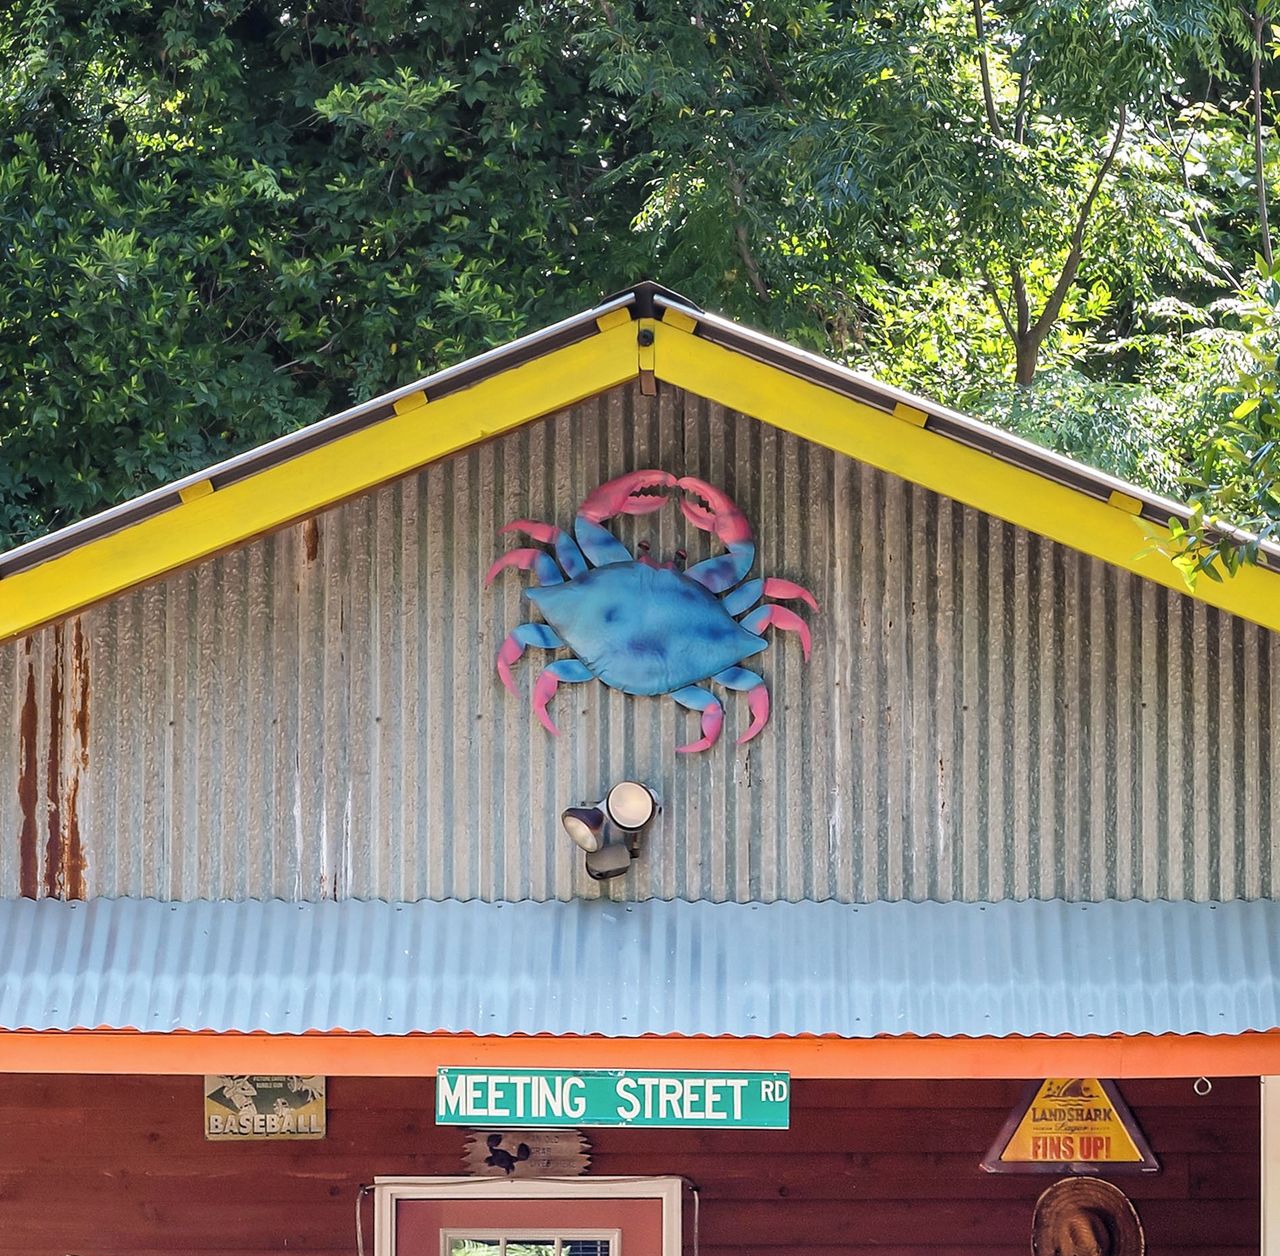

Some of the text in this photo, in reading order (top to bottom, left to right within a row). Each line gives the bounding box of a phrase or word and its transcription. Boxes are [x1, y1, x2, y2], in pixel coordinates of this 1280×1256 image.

[438, 1075, 788, 1120] MEETING STREET RD
[209, 1114, 322, 1135] BASEBALL
[1032, 1136, 1111, 1160] FINS UP!
